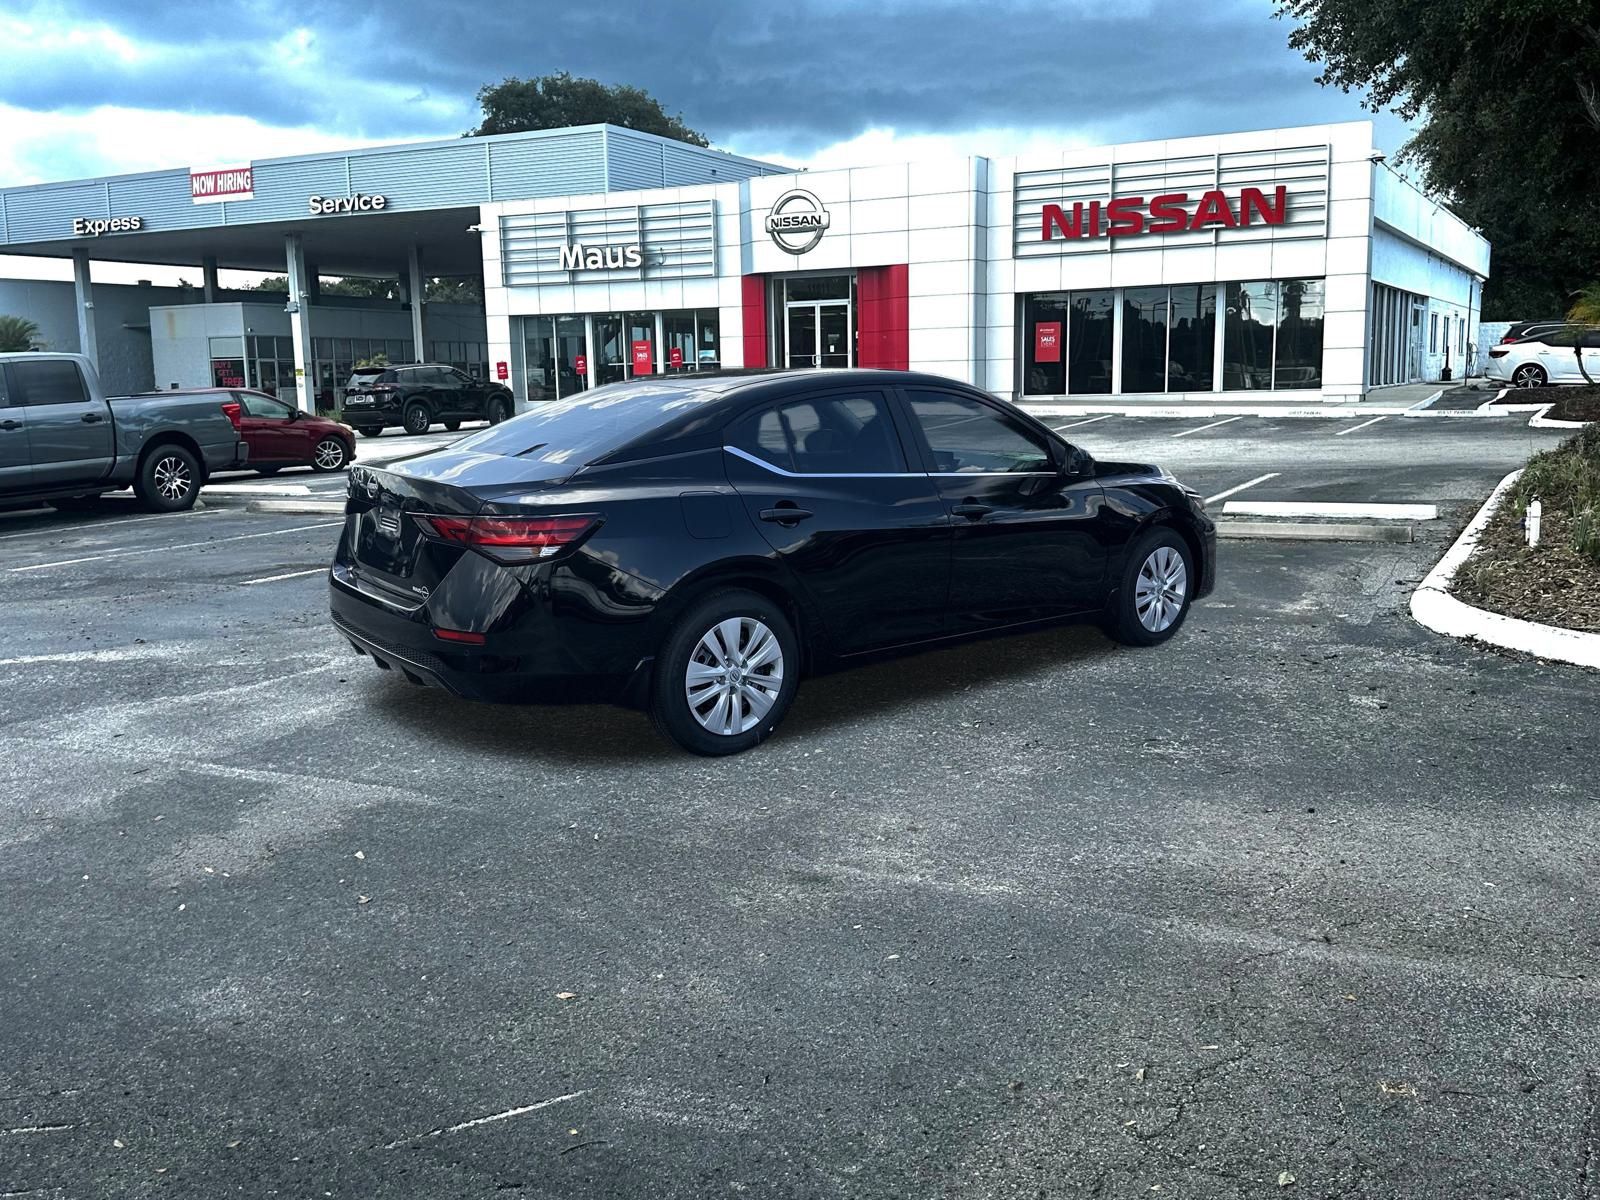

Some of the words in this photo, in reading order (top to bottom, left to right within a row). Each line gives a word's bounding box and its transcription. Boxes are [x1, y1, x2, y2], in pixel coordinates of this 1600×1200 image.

[192, 174, 215, 194] NOW
[216, 171, 251, 193] HIRING
[309, 193, 385, 215] Service
[1042, 185, 1287, 241] NISSAN
[73, 216, 141, 236] Express
[770, 215, 821, 228] NISSAN
[559, 243, 642, 271] Maus
[223, 377, 244, 387] FREE
